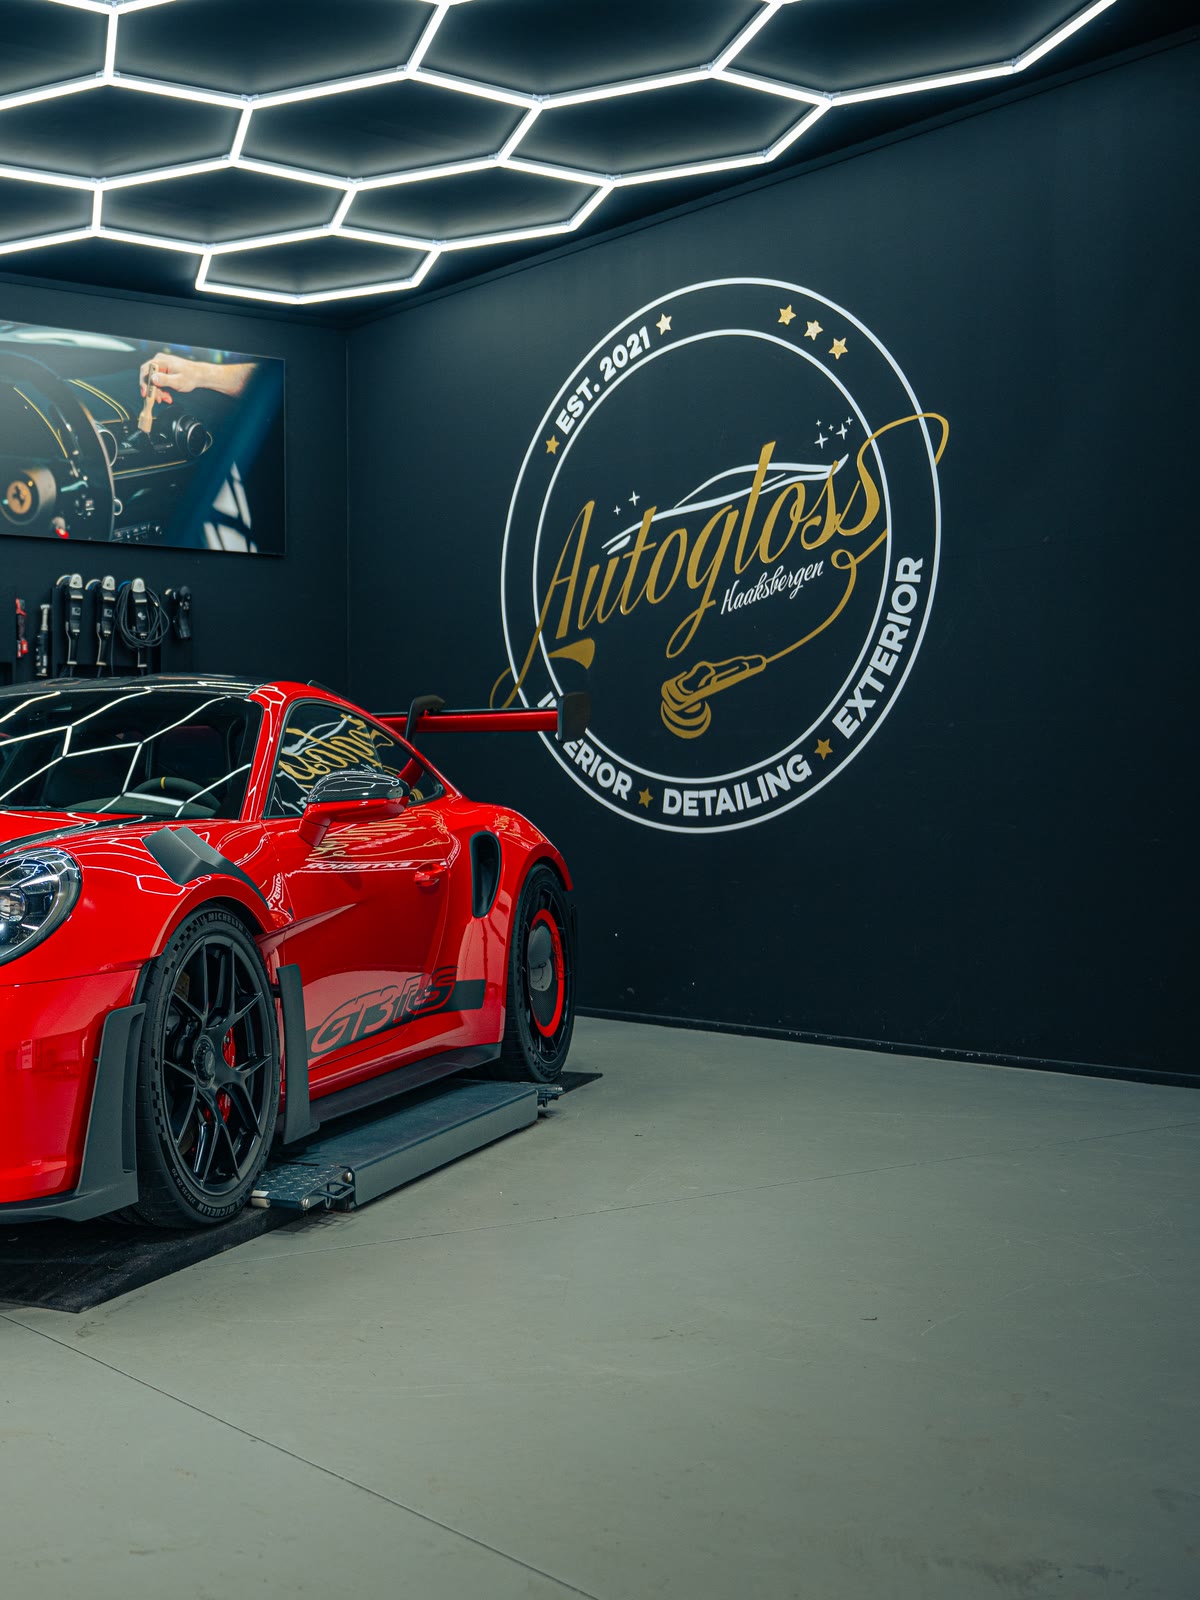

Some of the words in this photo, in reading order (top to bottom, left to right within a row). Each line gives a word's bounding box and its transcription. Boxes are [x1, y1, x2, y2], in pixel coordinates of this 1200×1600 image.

[555, 377, 600, 435] EST.
[600, 326, 651, 382] 2021
[495, 412, 930, 705] Autogloss
[720, 560, 824, 615] Haaksbergen
[832, 557, 924, 740] EXTERIOR
[662, 754, 813, 817] DETAILING
[207, 912, 244, 931] MICHELIN
[196, 1201, 237, 1218] MICHELIN
